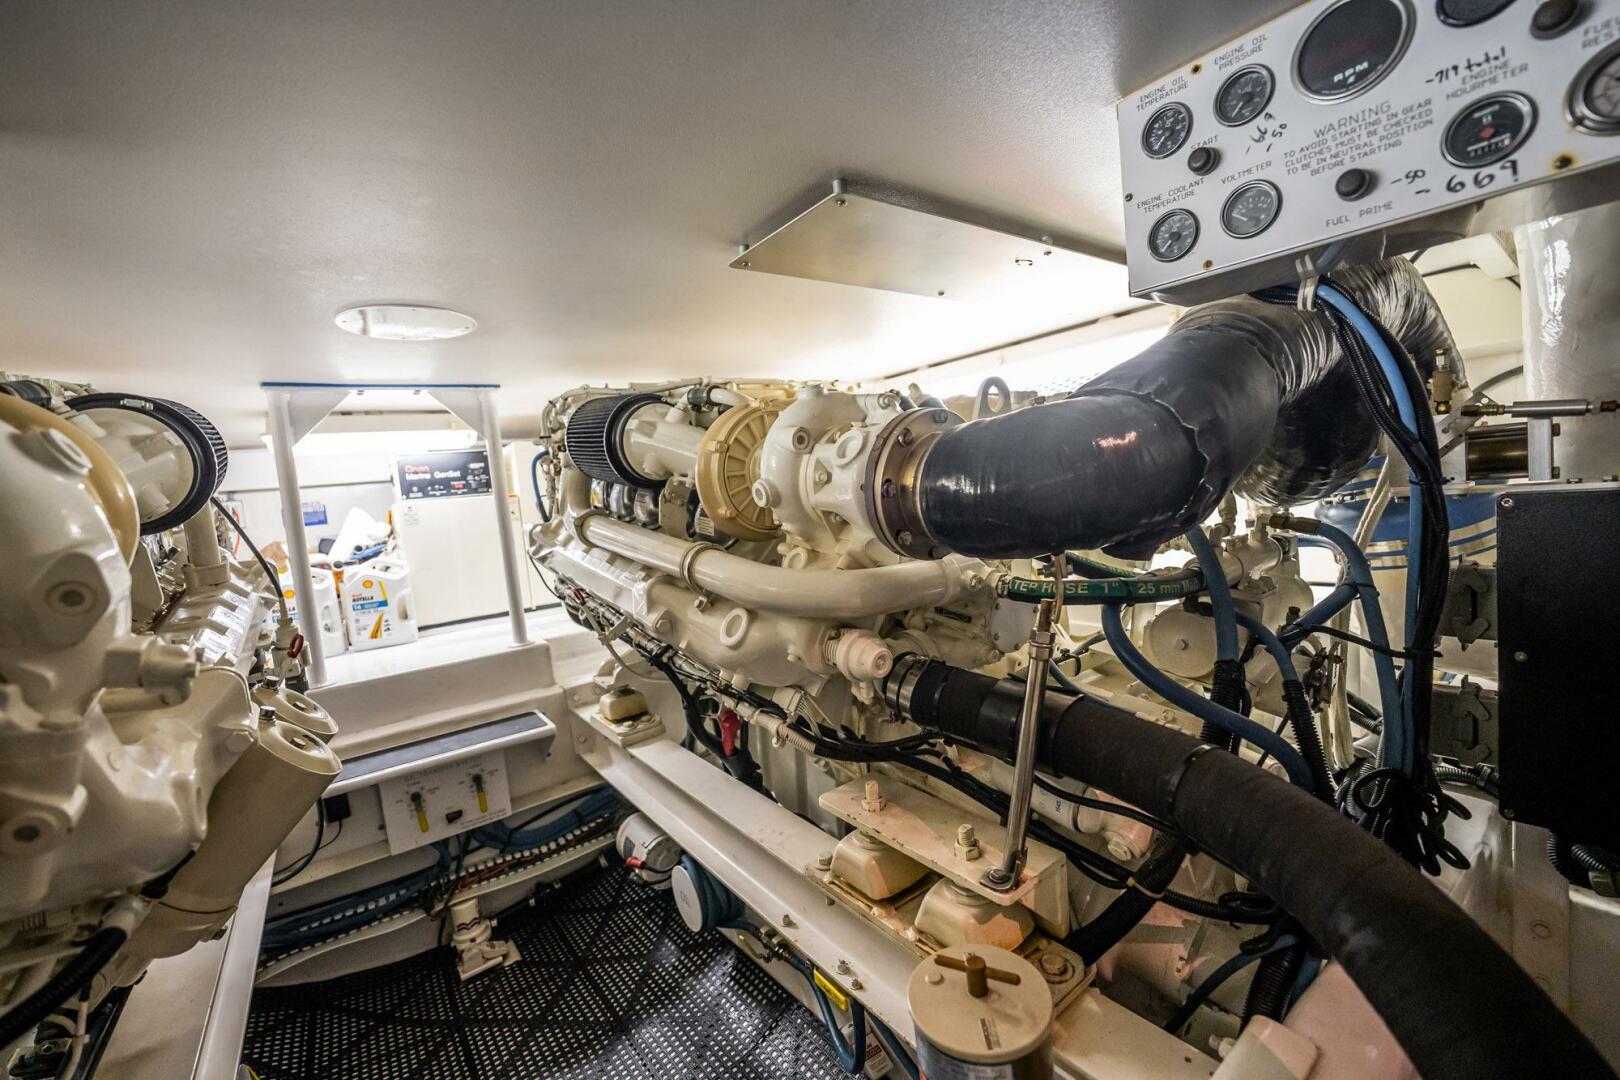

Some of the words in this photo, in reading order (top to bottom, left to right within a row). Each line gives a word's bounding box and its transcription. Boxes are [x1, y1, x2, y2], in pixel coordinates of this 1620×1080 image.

[1214, 43, 1245, 65] ENGINE
[1252, 33, 1268, 46] OIL
[1219, 43, 1264, 71] PRESSURE
[1333, 61, 1369, 83] RPM
[1446, 62, 1529, 101] HOURMETER
[1461, 59, 1509, 86] ENGINE
[1136, 81, 1189, 112] TEMPERATURE
[1140, 84, 1167, 103] ENGINE
[1171, 75, 1186, 87] OIL
[1283, 150, 1296, 160] TO
[1300, 138, 1328, 154] AVOID
[1331, 118, 1382, 143] STARTING
[1386, 113, 1398, 123] IN
[1401, 98, 1432, 116] GEAR
[1313, 100, 1392, 139] WARNING
[1190, 134, 1219, 150] START
[1284, 144, 1333, 168] CLUTCHES
[1335, 134, 1363, 154] MUST
[1366, 128, 1378, 139] BE
[1383, 108, 1433, 135] CHECKED
[1286, 166, 1299, 176] TO
[1301, 160, 1313, 171] BE
[1316, 156, 1328, 166] IN
[1329, 141, 1374, 161] NEUTRAL
[1379, 118, 1434, 143] POSITION
[1310, 158, 1347, 177] BEFORE
[1349, 138, 1403, 163] STARTING
[1220, 160, 1273, 185] VOLTMETER
[1136, 193, 1163, 209] ENGINE
[1167, 177, 1205, 197] COOLANT
[1143, 189, 1196, 214] TEMPERATURE
[1325, 214, 1351, 228] FUEL
[1358, 200, 1393, 218] PRIME
[1137, 582, 1156, 594] 25
[1160, 583, 1181, 594] mm
